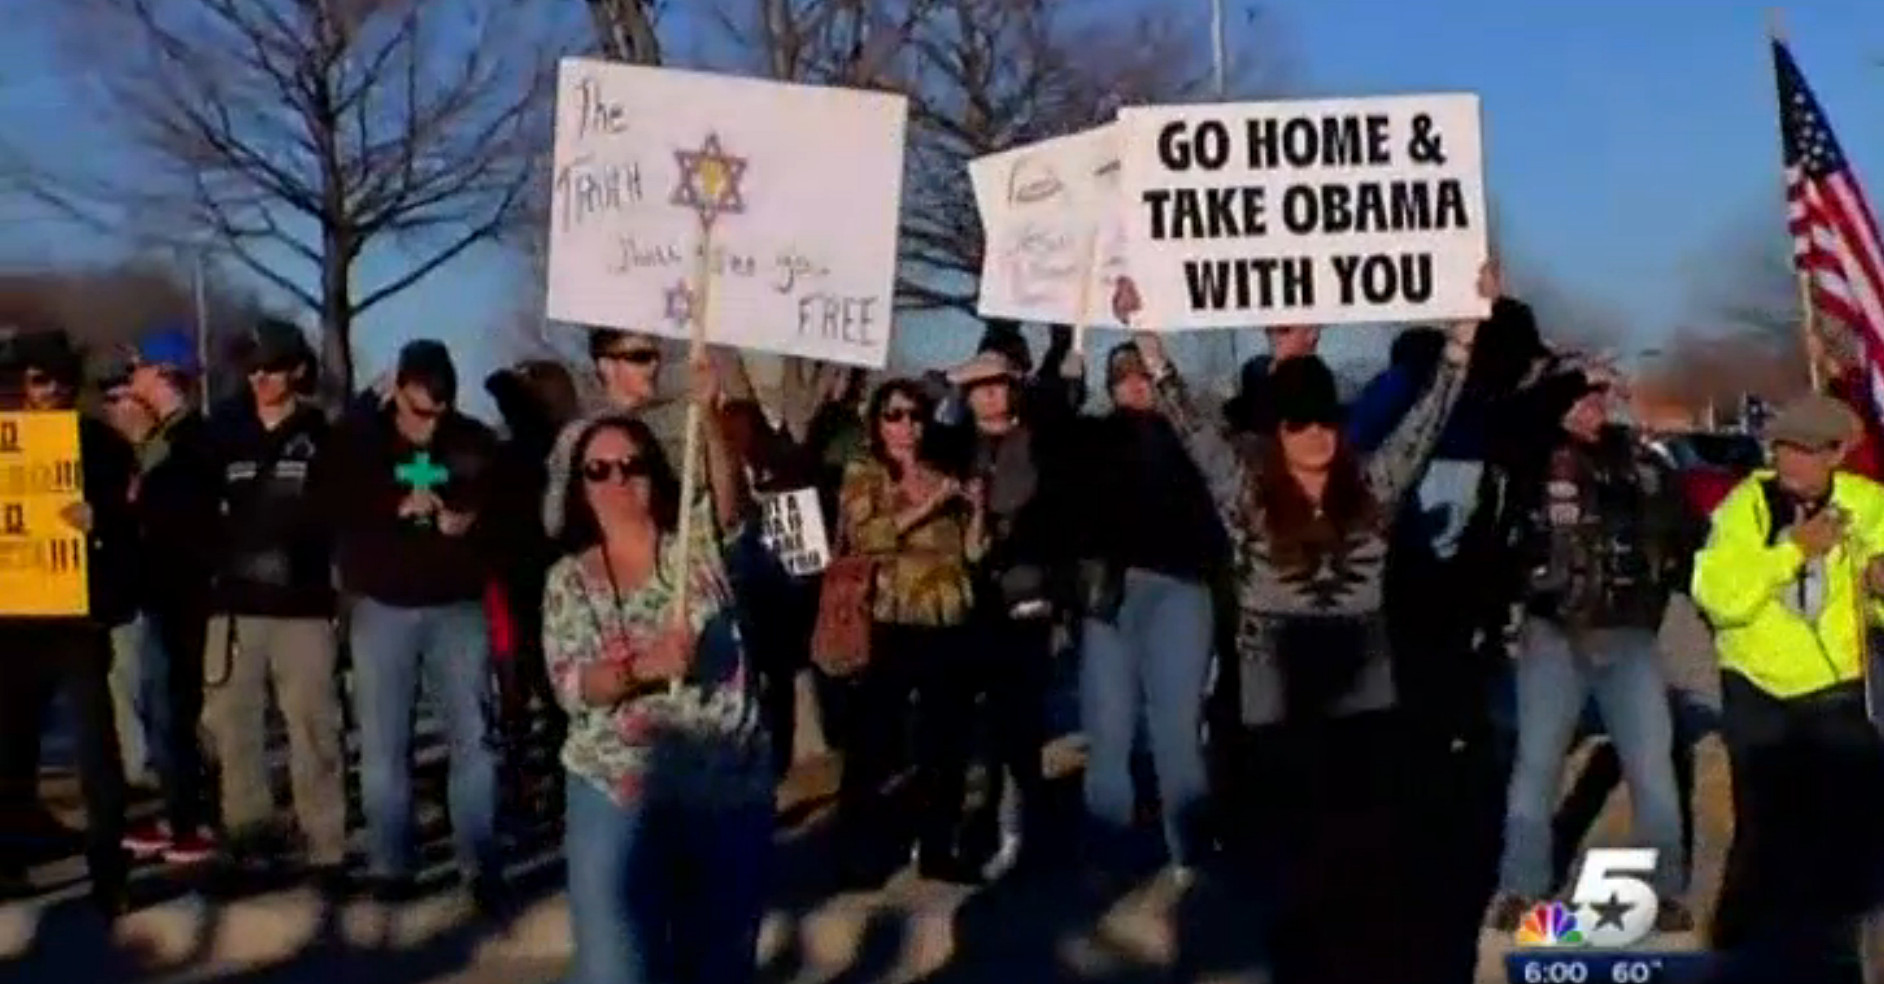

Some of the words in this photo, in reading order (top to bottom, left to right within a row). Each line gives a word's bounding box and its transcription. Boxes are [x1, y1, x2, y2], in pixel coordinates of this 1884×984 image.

[575, 77, 629, 139] The
[1158, 119, 1230, 172] GO
[1248, 115, 1391, 170] HOME
[1407, 113, 1446, 166] &
[1143, 187, 1267, 240] TAKE
[1282, 179, 1468, 237] OBAMA
[1184, 258, 1314, 310] WITH
[1331, 253, 1433, 305] YOU
[798, 292, 879, 346] FREE
